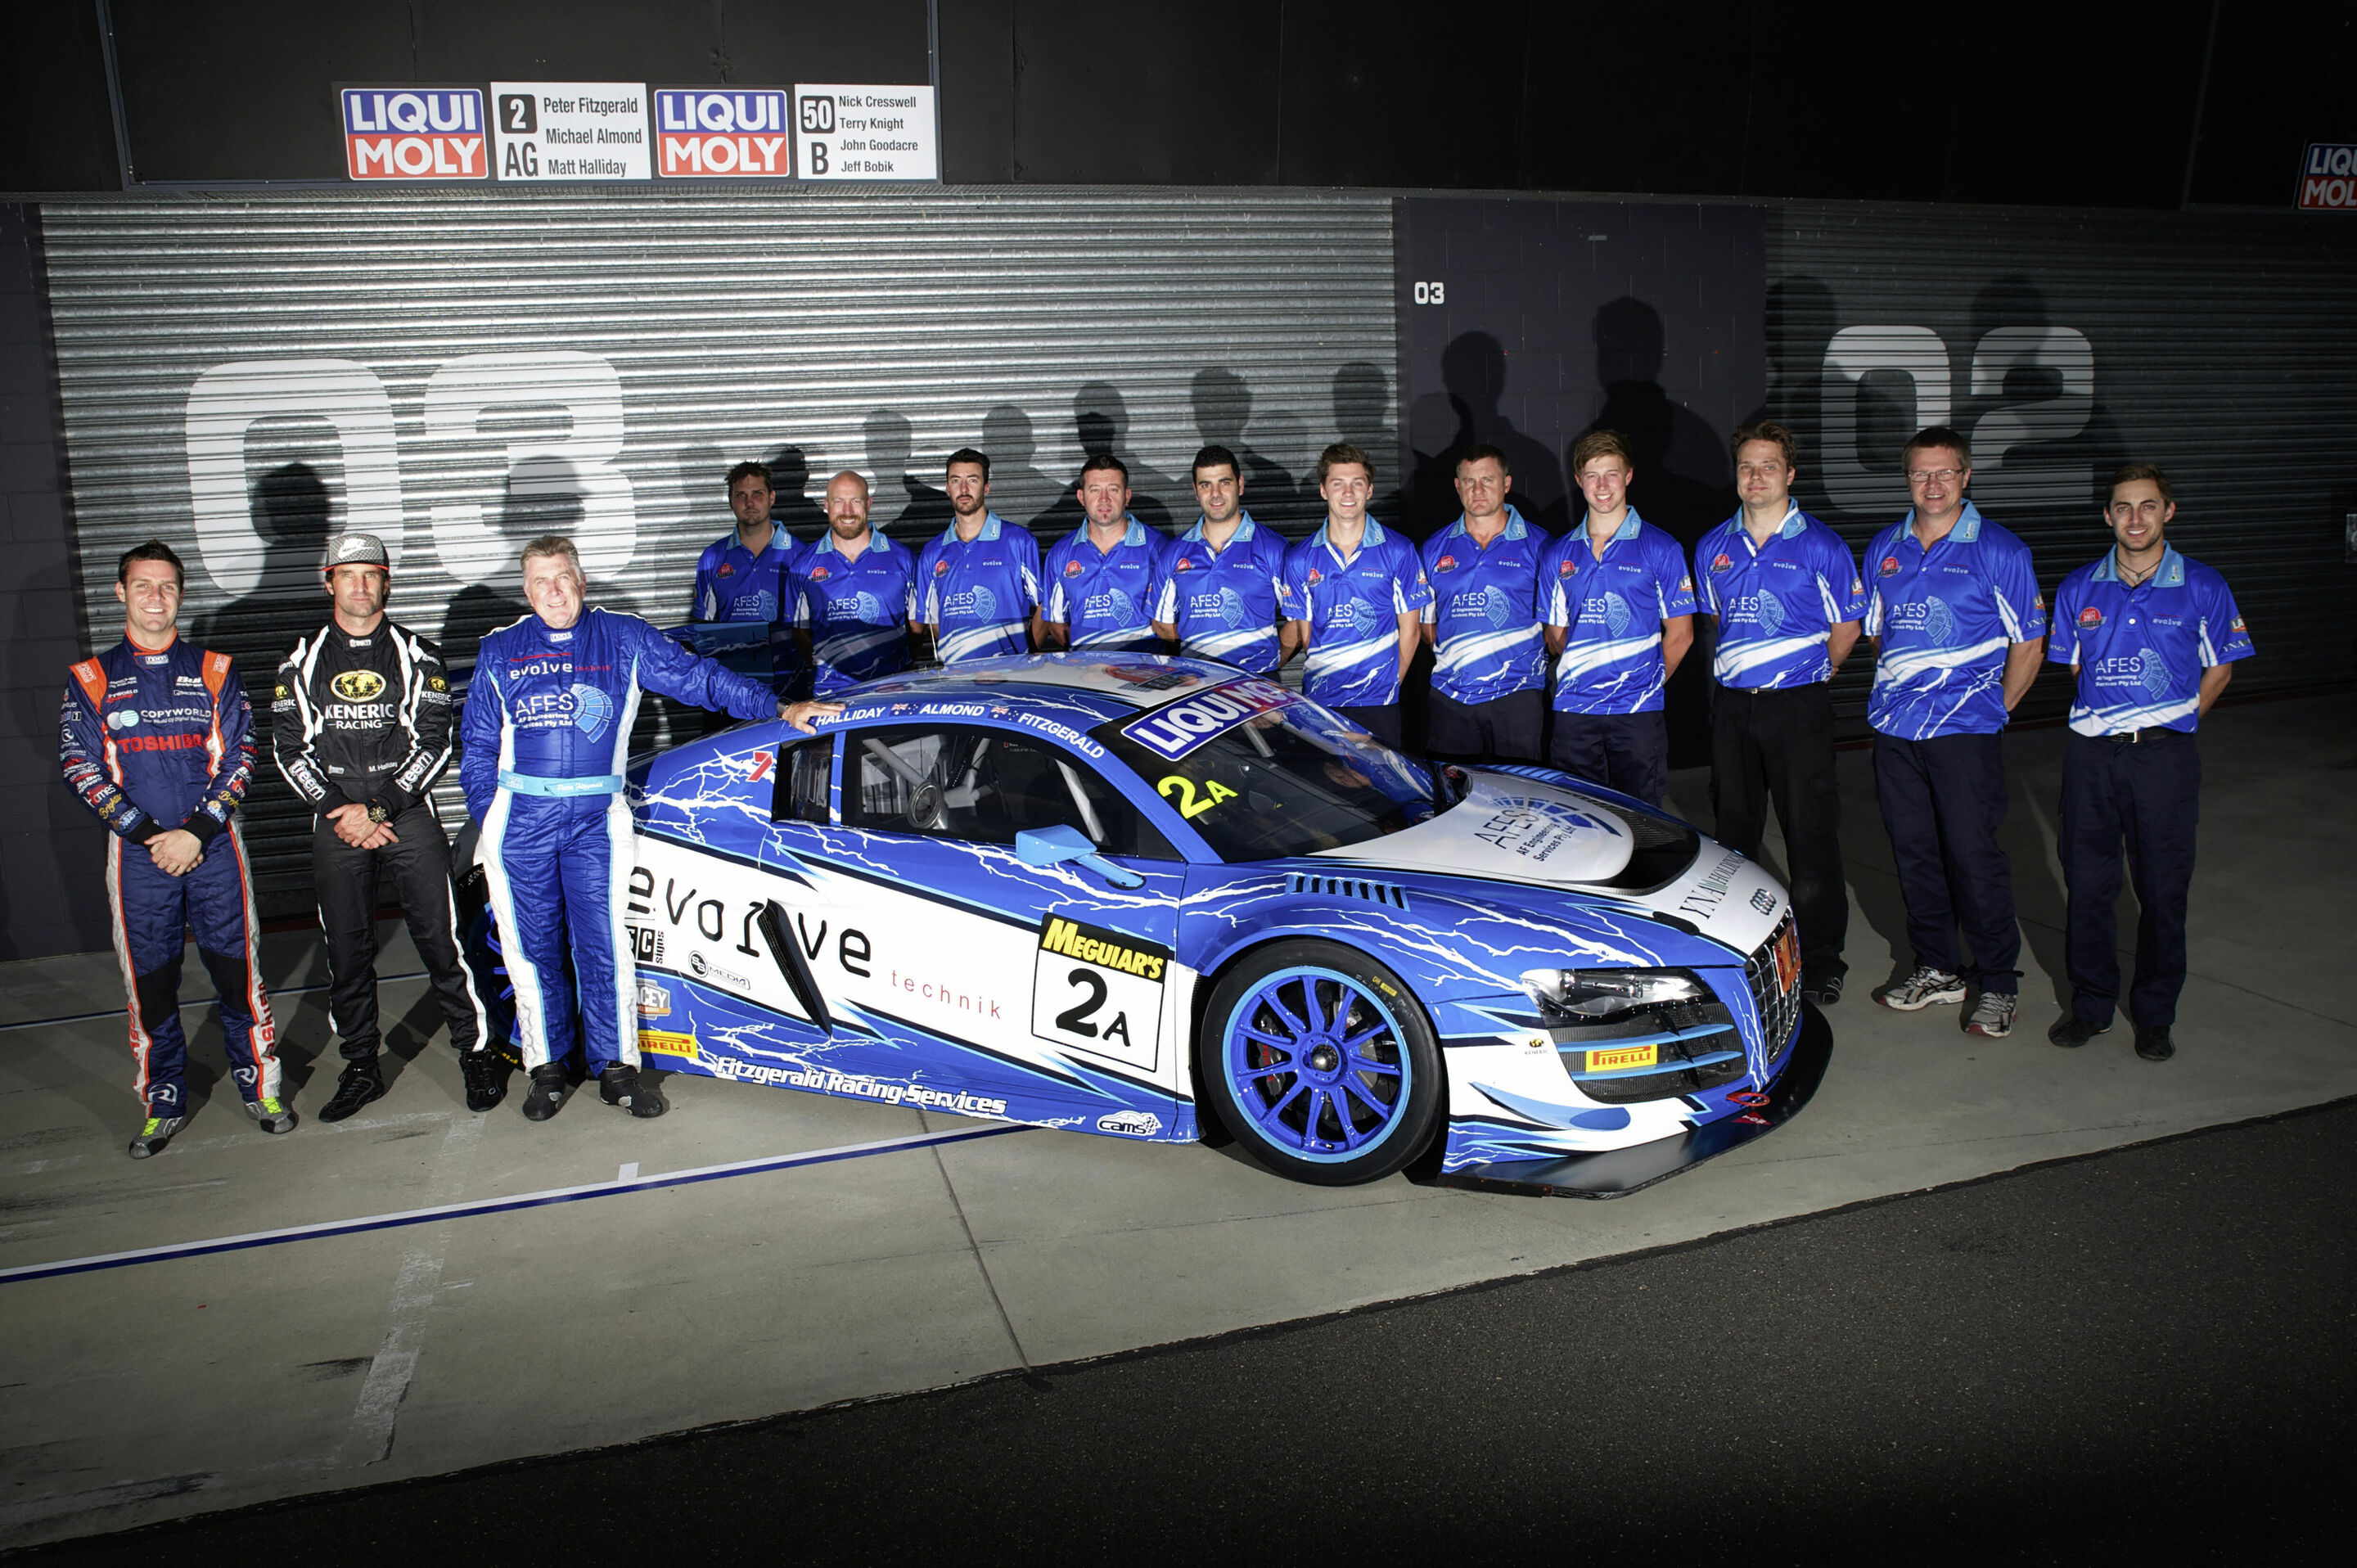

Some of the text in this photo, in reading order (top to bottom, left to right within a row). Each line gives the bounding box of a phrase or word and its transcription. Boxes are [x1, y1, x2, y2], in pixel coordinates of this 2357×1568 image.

[543, 97, 638, 116] Peter Fitzgerald
[839, 96, 917, 108] Nick Cresswell
[350, 94, 477, 133] LIQUI
[510, 98, 526, 128] 2
[663, 94, 780, 133] LIQUI
[803, 99, 833, 130] 50
[840, 118, 904, 132] Terry Knight
[546, 128, 642, 144] Michael Almond
[840, 140, 918, 151] John Goodacre
[354, 137, 482, 174] MOLY
[504, 142, 539, 177] AG
[665, 136, 785, 173] MOLY
[811, 142, 830, 175] B
[548, 159, 627, 178] Matt Halliday
[840, 160, 895, 173] Jeff Bobik
[1414, 282, 1445, 304] 03
[1821, 326, 2094, 514] 02
[186, 350, 637, 598] 03
[1617, 565, 1643, 574] evolve
[1773, 561, 1797, 570] evolve
[1942, 566, 1970, 574] evolve
[733, 595, 759, 607] AFES
[827, 598, 858, 611] AFES
[944, 593, 974, 607] AFES
[1190, 593, 1221, 609] AFES
[1451, 592, 1486, 608] AFES
[2152, 617, 2183, 627] evolve
[510, 661, 573, 680] evolve
[2095, 656, 2142, 674] AFES
[141, 708, 212, 719] COPYWORLD
[325, 704, 395, 719] KENERIC
[516, 693, 574, 718] AFES
[336, 719, 383, 730] RACING
[815, 706, 887, 728] HALLIDAY
[919, 704, 985, 717] ALMOND
[1017, 712, 1106, 759] FITZGERALD
[1133, 692, 1251, 754] LIQUI
[1516, 822, 1562, 856] AF Engineering
[1532, 838, 1562, 862] Services
[655, 930, 665, 965] signs
[1042, 917, 1165, 980] MEGUIAR'S
[891, 969, 1003, 1021] technik
[1592, 1045, 1652, 1066] PIRELLI
[715, 1056, 1008, 1115] Fitzgerald Racing Services
